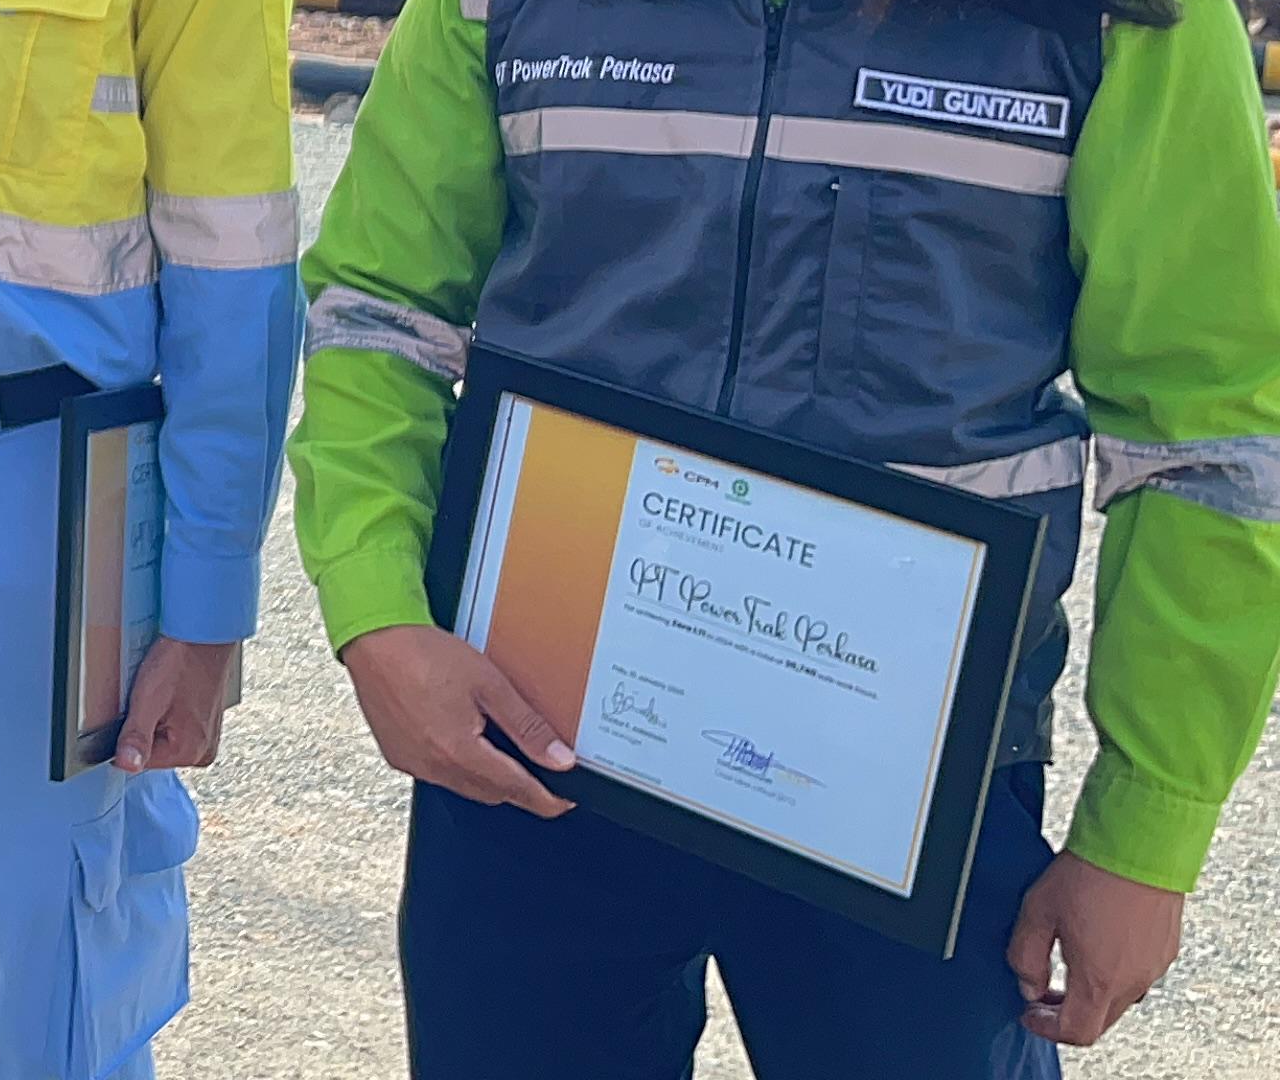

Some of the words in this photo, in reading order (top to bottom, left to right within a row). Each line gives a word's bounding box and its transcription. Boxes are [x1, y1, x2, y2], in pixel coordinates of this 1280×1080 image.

[512, 55, 594, 84] PowerTrak
[599, 55, 676, 85] Perkasa
[881, 80, 936, 110] YUDI
[943, 90, 1048, 126] GUNTARA
[683, 470, 720, 490] CPM
[642, 492, 817, 569] CERTIFICATE
[629, 557, 680, 602] PT
[794, 613, 879, 673] Perkasa
